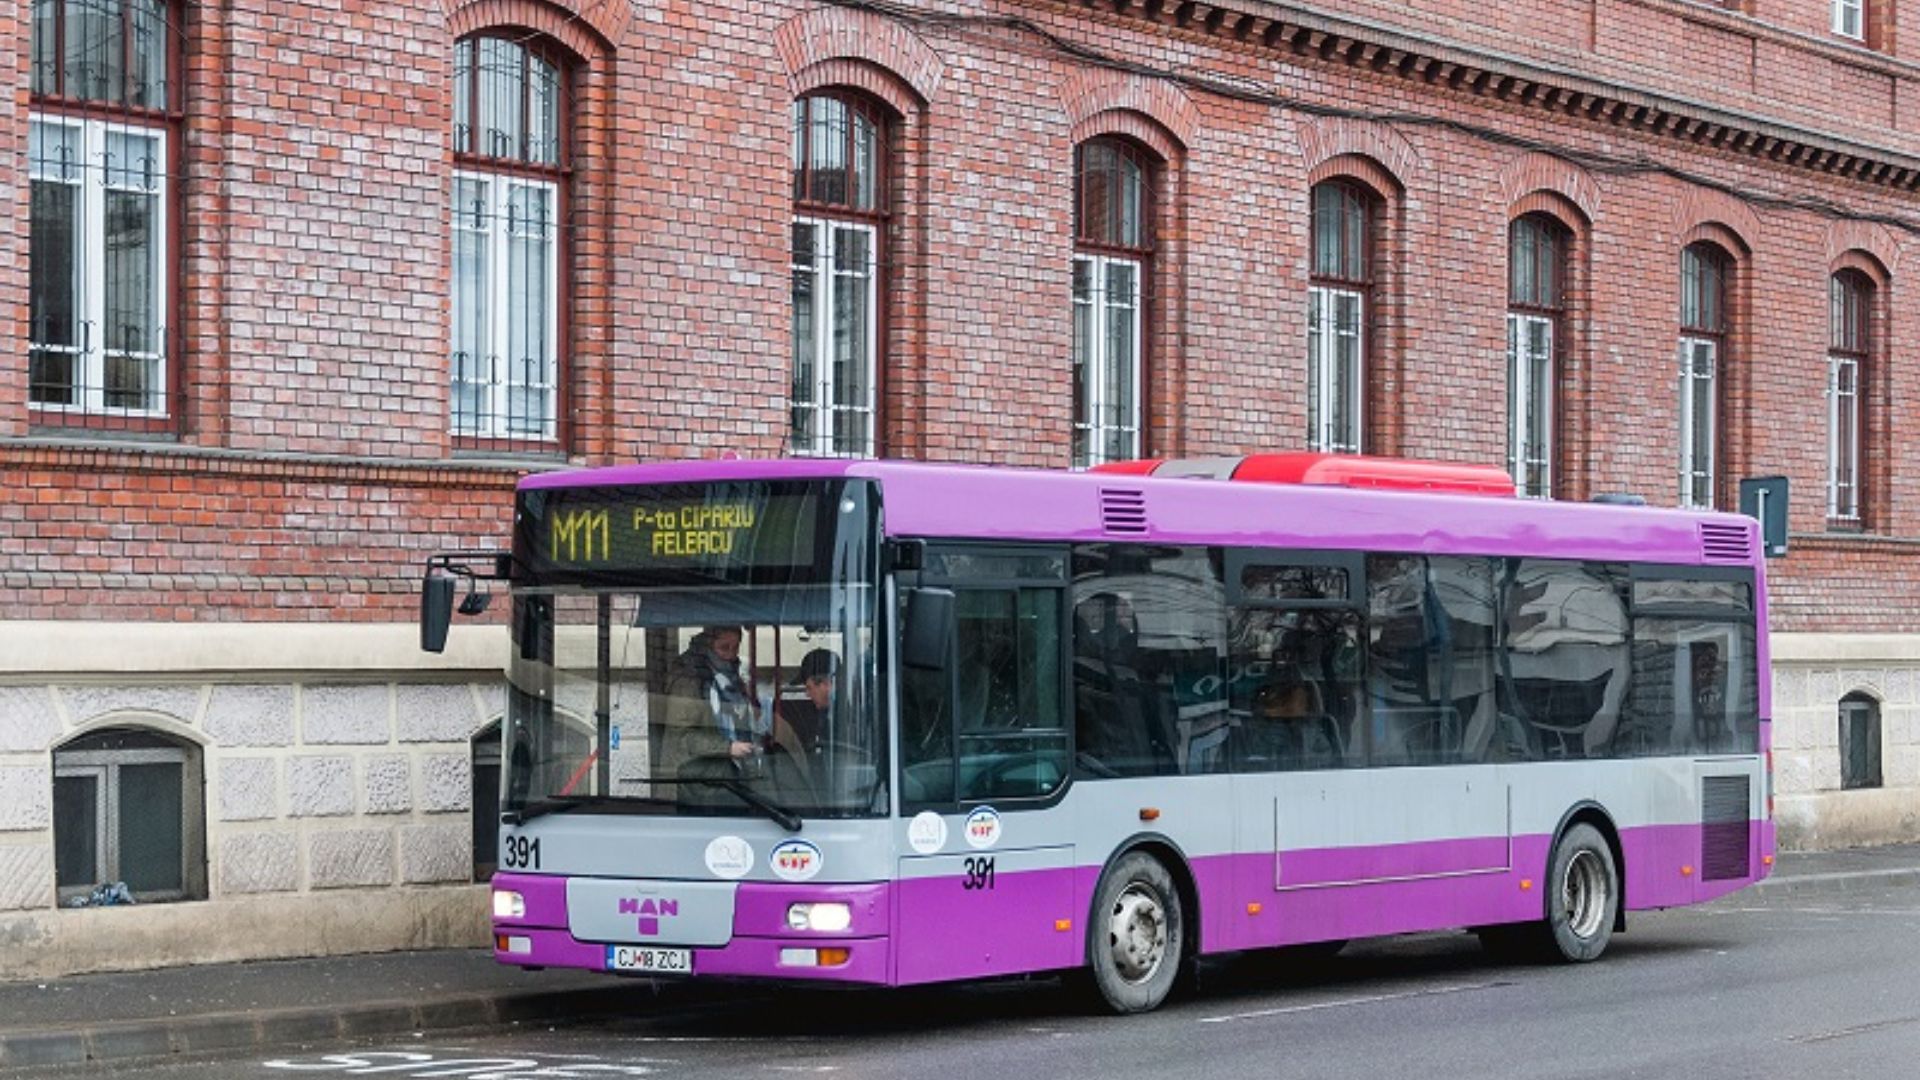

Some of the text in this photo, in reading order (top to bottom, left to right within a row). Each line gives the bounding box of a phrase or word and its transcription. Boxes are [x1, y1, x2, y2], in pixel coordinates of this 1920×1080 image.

[680, 504, 755, 529] CIPARIU
[551, 508, 609, 561] M11
[651, 530, 734, 555] FELEACU
[505, 835, 541, 870] 391
[962, 856, 995, 890] 391
[618, 898, 679, 917] MAN
[656, 951, 687, 969] ZCJ
